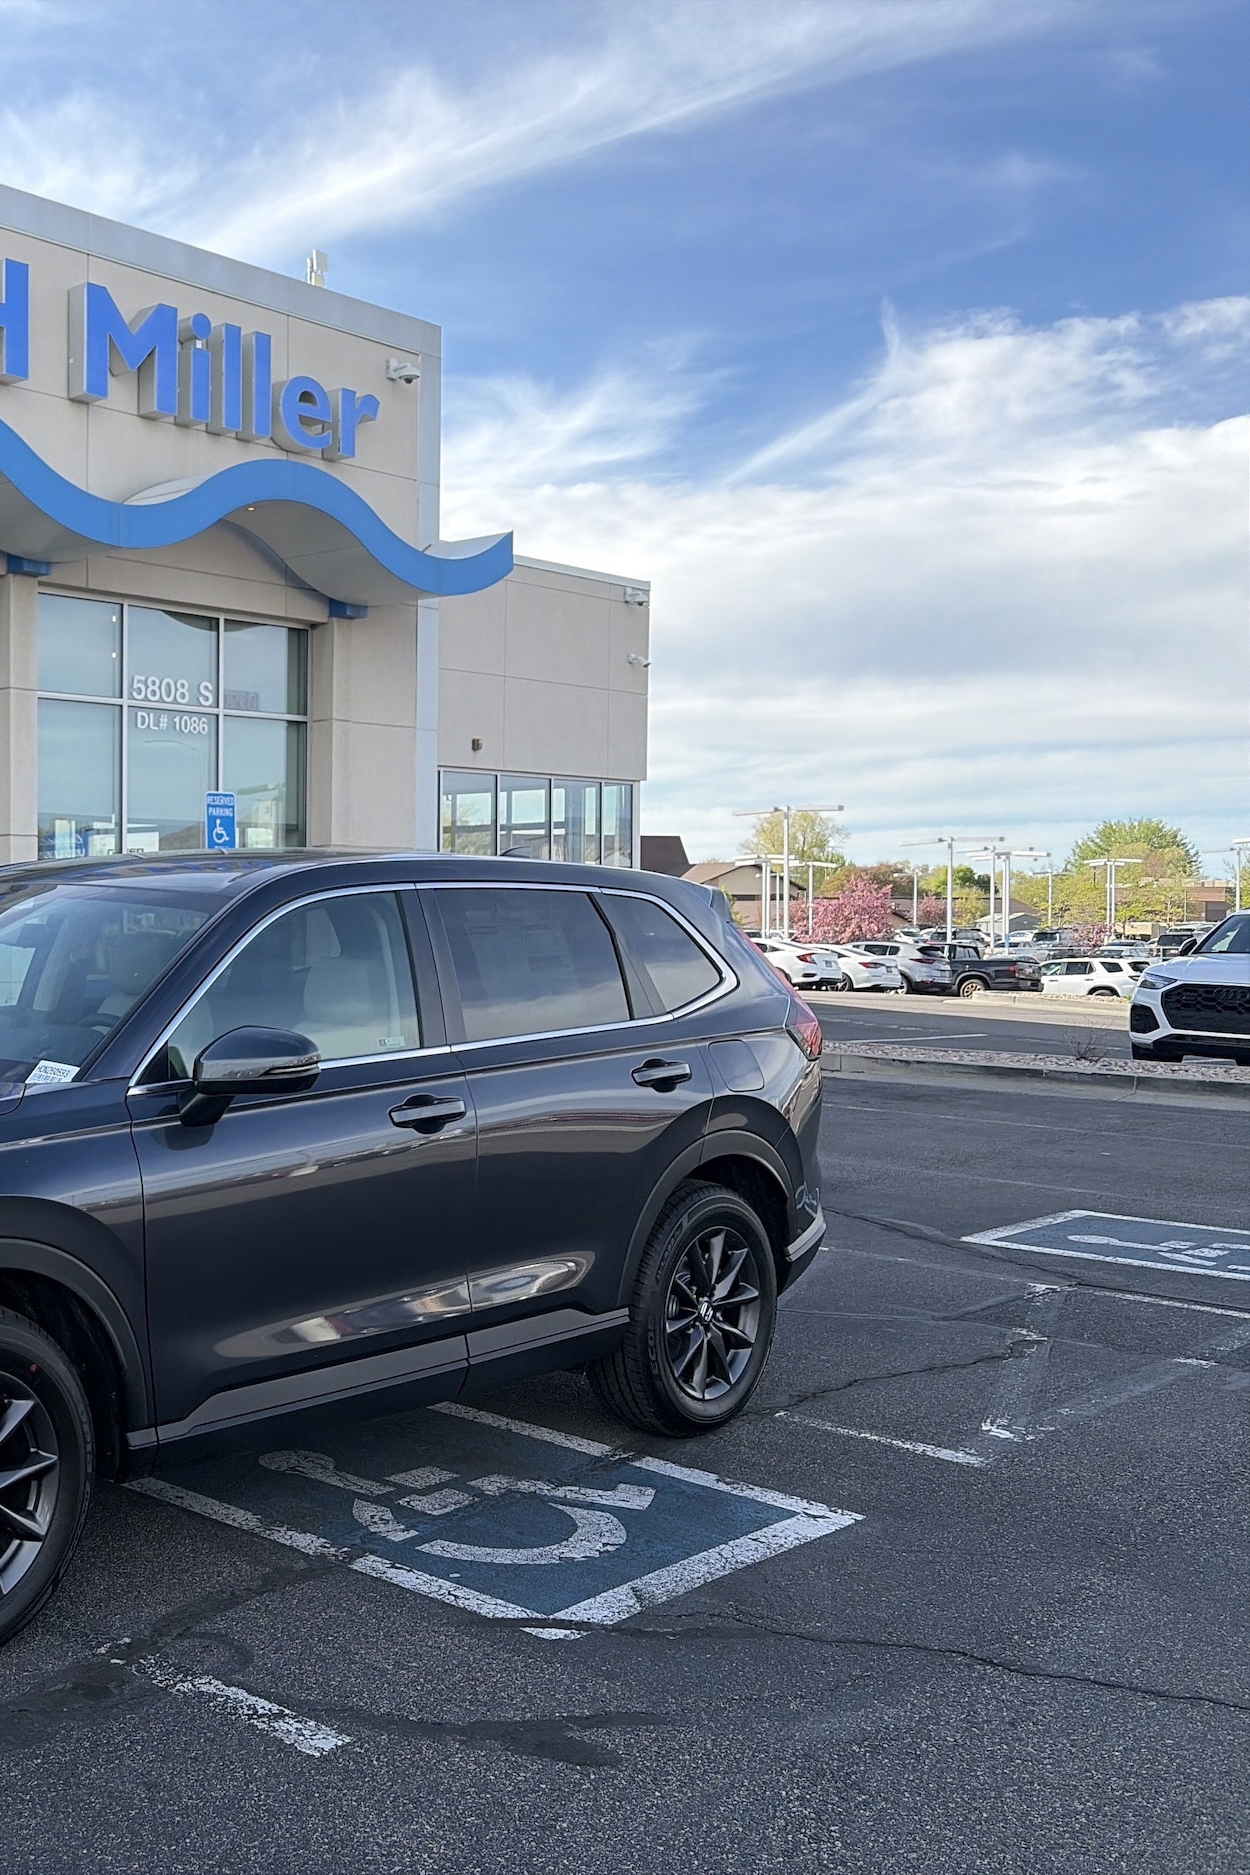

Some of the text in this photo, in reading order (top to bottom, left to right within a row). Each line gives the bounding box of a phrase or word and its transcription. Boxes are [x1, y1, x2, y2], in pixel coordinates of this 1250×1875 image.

[69, 282, 380, 459] Miller
[132, 675, 190, 704] 5808
[198, 681, 214, 706] S
[137, 711, 209, 735] DL# 1086
[207, 795, 234, 806] RESERVED
[208, 806, 234, 817] PARKING
